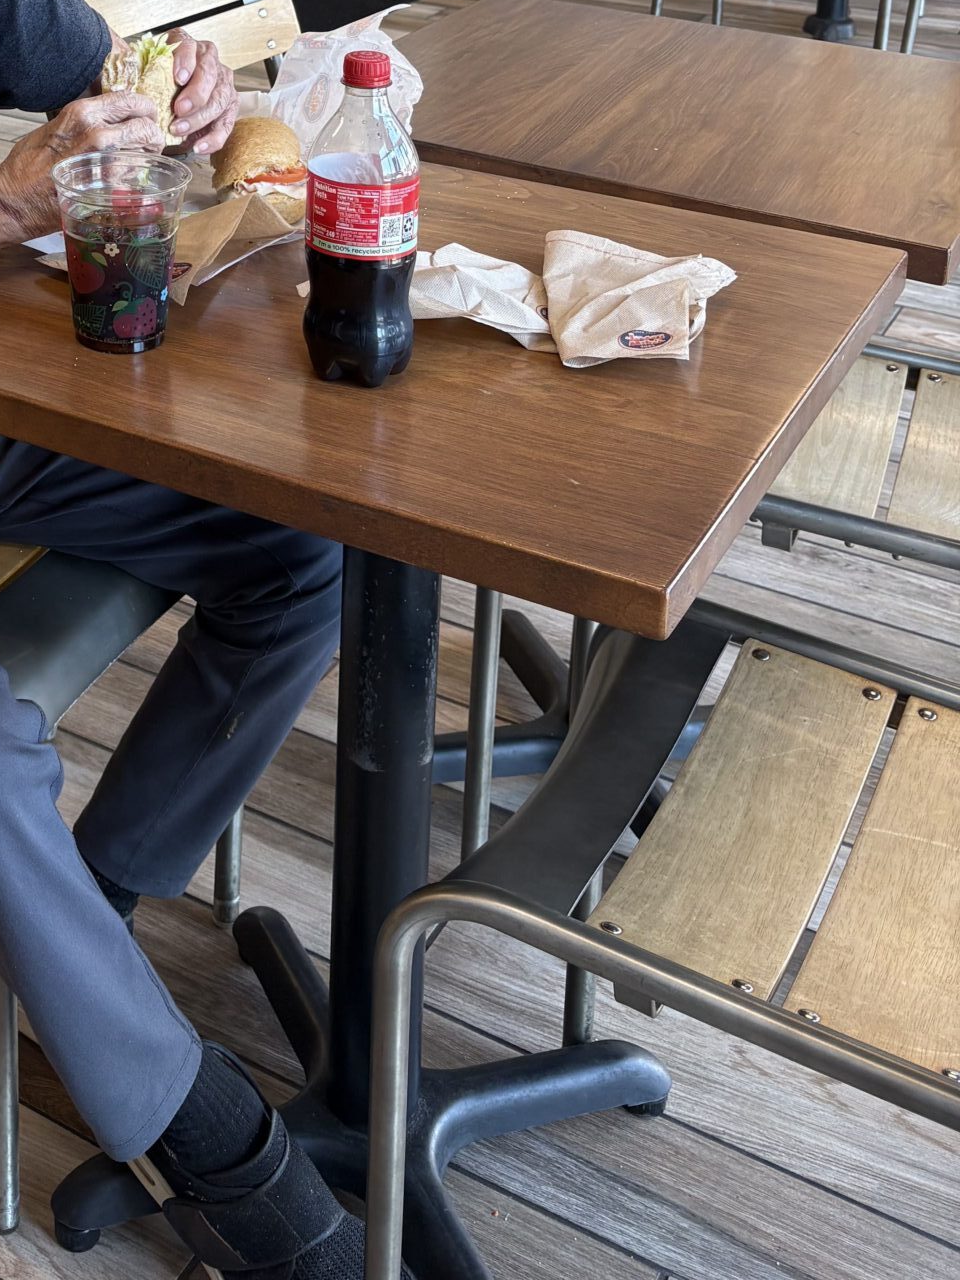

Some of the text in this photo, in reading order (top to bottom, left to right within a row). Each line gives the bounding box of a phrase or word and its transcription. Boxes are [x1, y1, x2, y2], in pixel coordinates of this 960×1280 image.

[314, 181, 337, 194] Nutrition
[314, 188, 327, 199] Facts
[332, 244, 351, 253] 100%
[351, 247, 381, 256] recycled
